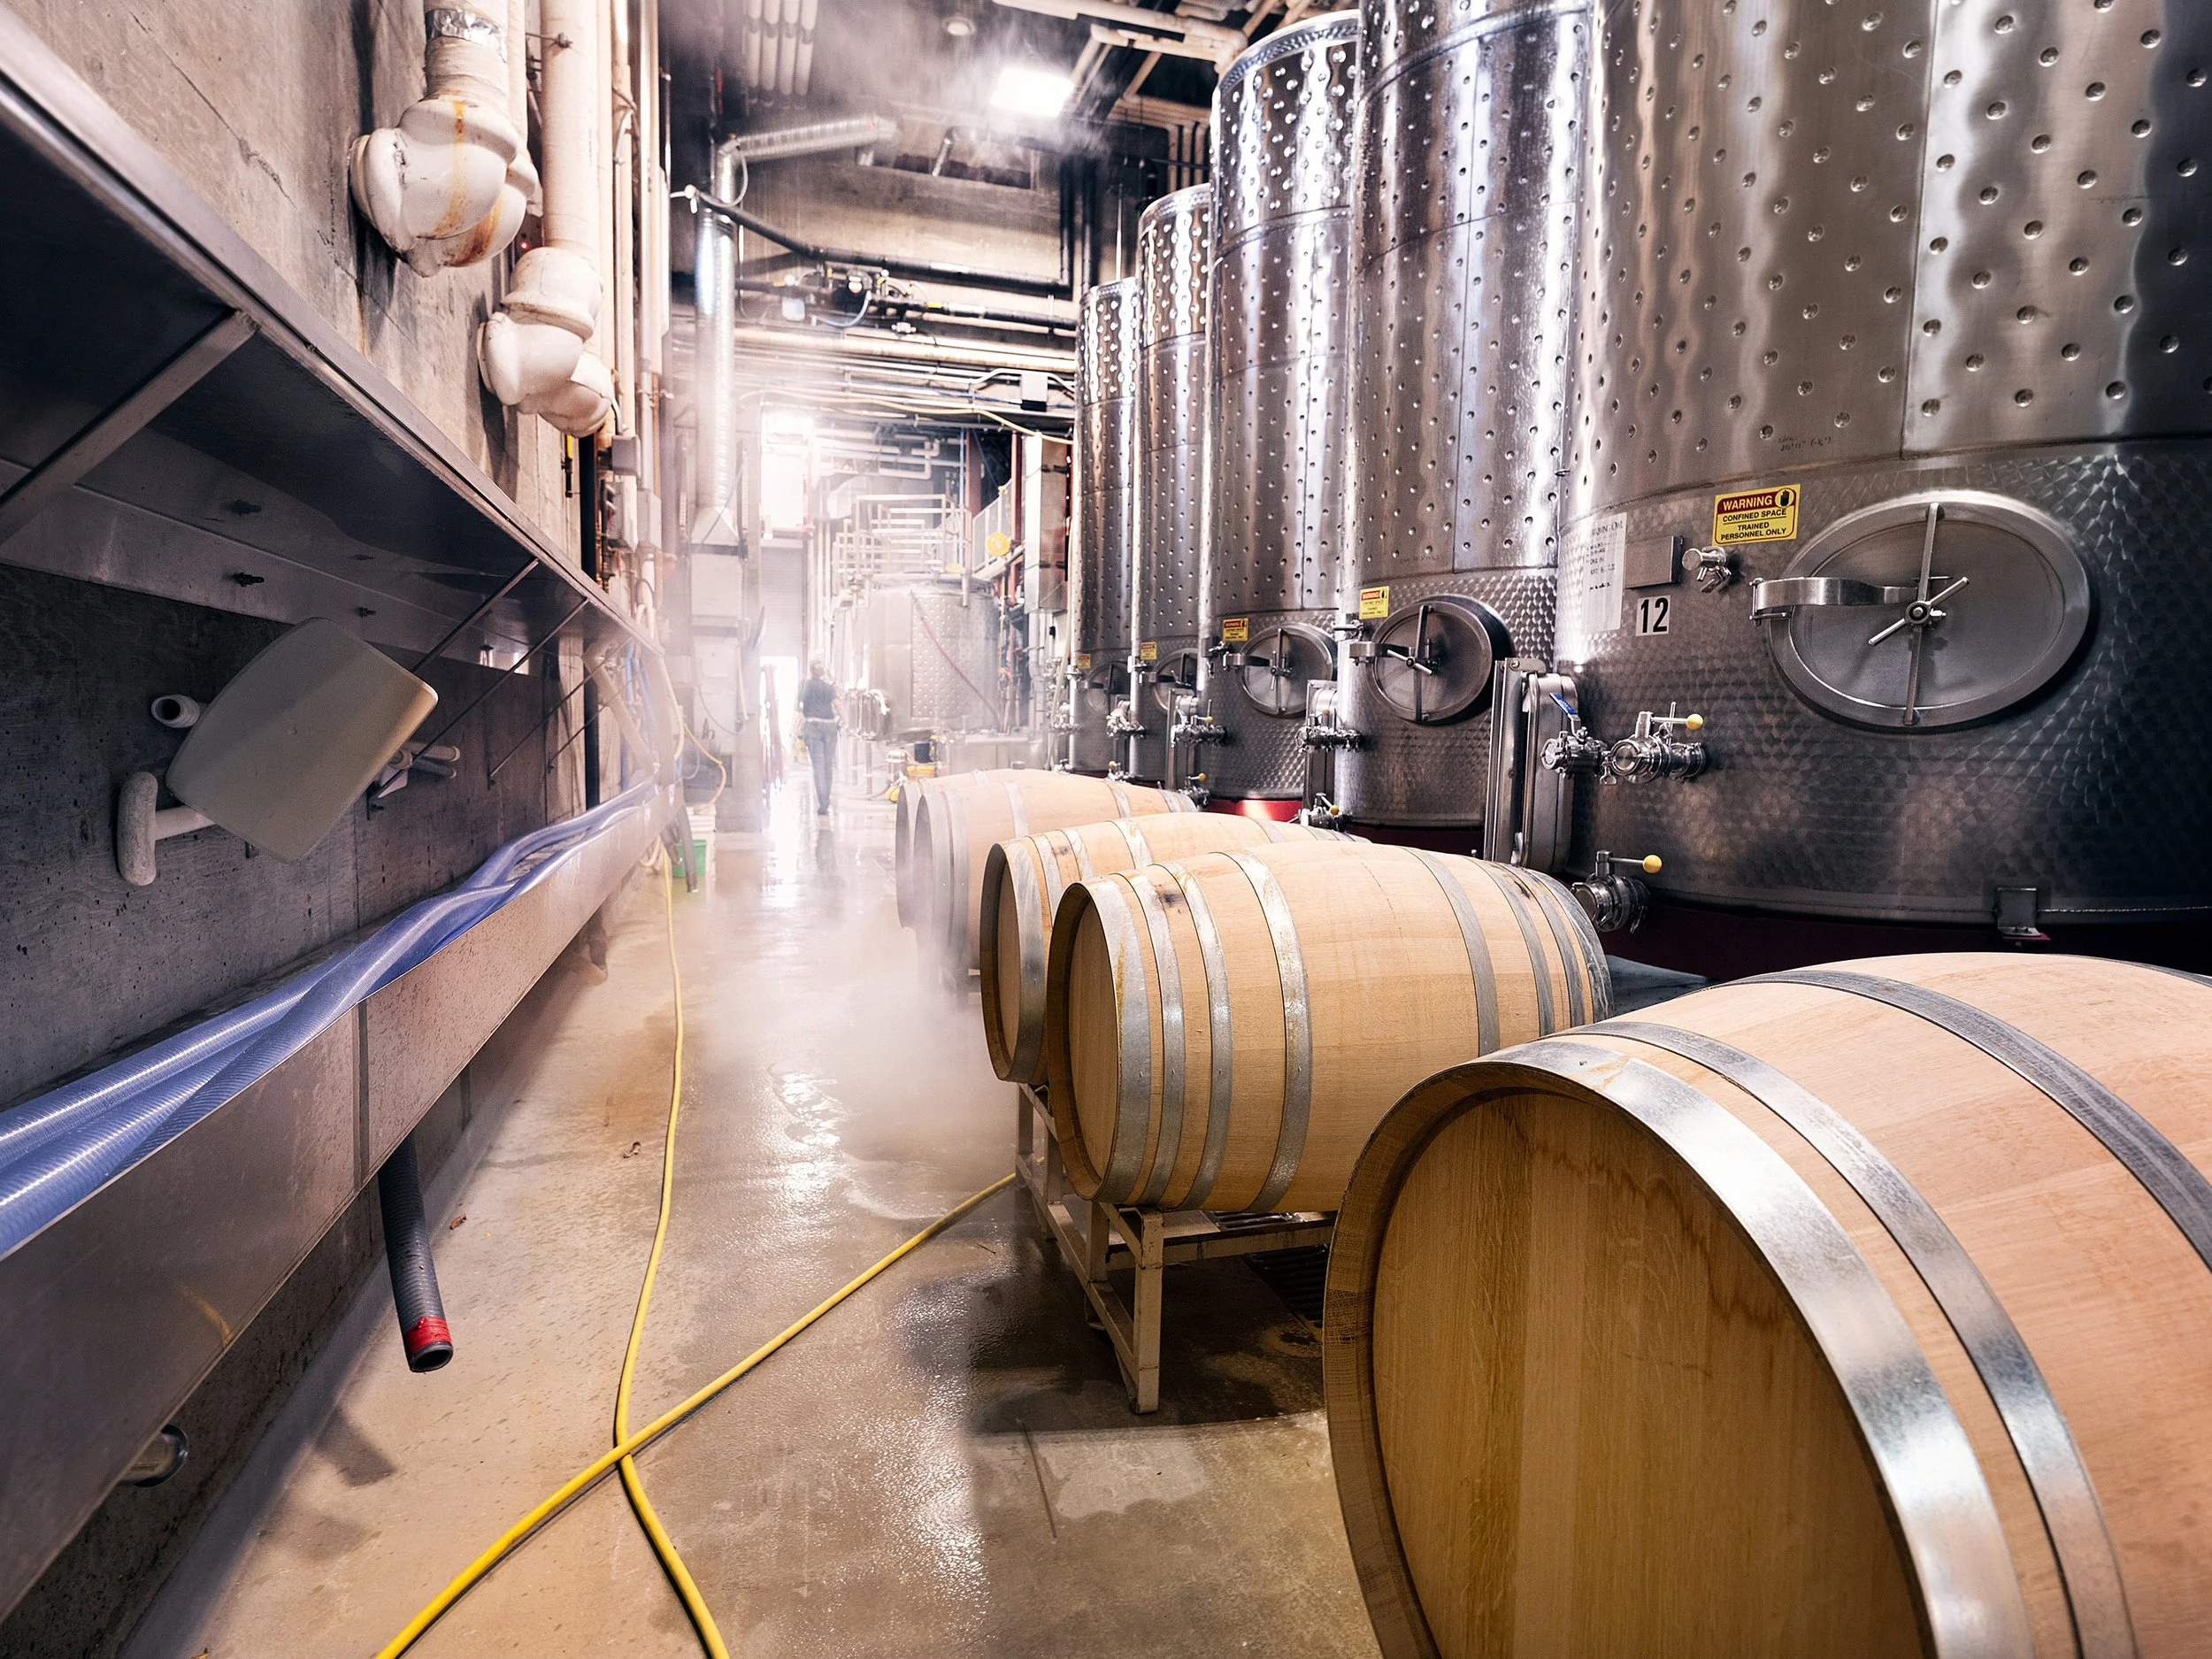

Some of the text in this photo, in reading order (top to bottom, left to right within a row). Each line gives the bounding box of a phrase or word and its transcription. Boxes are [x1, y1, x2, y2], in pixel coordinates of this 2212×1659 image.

[1723, 495, 1772, 511] WARNING
[1723, 509, 1786, 522] CONFINED SPACE
[1738, 522, 1770, 531] TRAINED
[1721, 530, 1763, 541] PERSONNEL
[1640, 597, 1669, 634] 12
